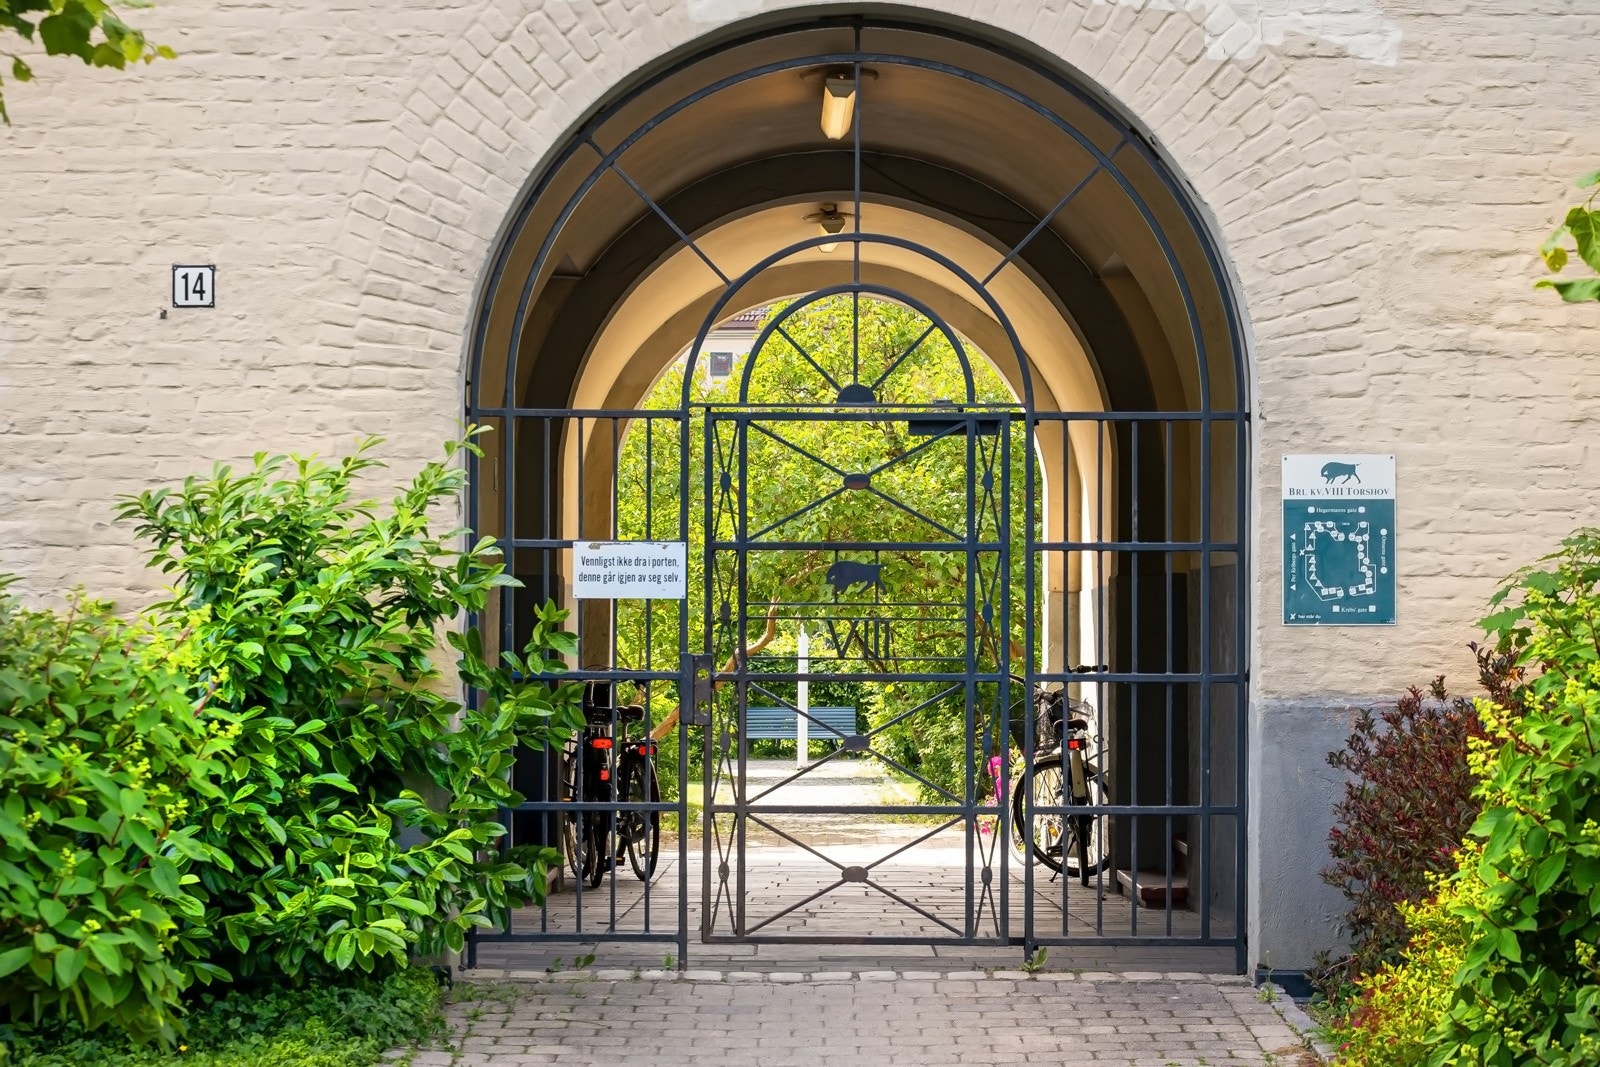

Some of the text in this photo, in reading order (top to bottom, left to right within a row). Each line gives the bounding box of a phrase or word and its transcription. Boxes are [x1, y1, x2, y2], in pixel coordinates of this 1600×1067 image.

[181, 272, 206, 301] 14
[1345, 487, 1390, 496] TORSHOV
[581, 556, 680, 569] Vennligst ikke dra i porten,
[578, 571, 682, 585] denne går igjen av seg selv.
[826, 618, 890, 659] VIII
